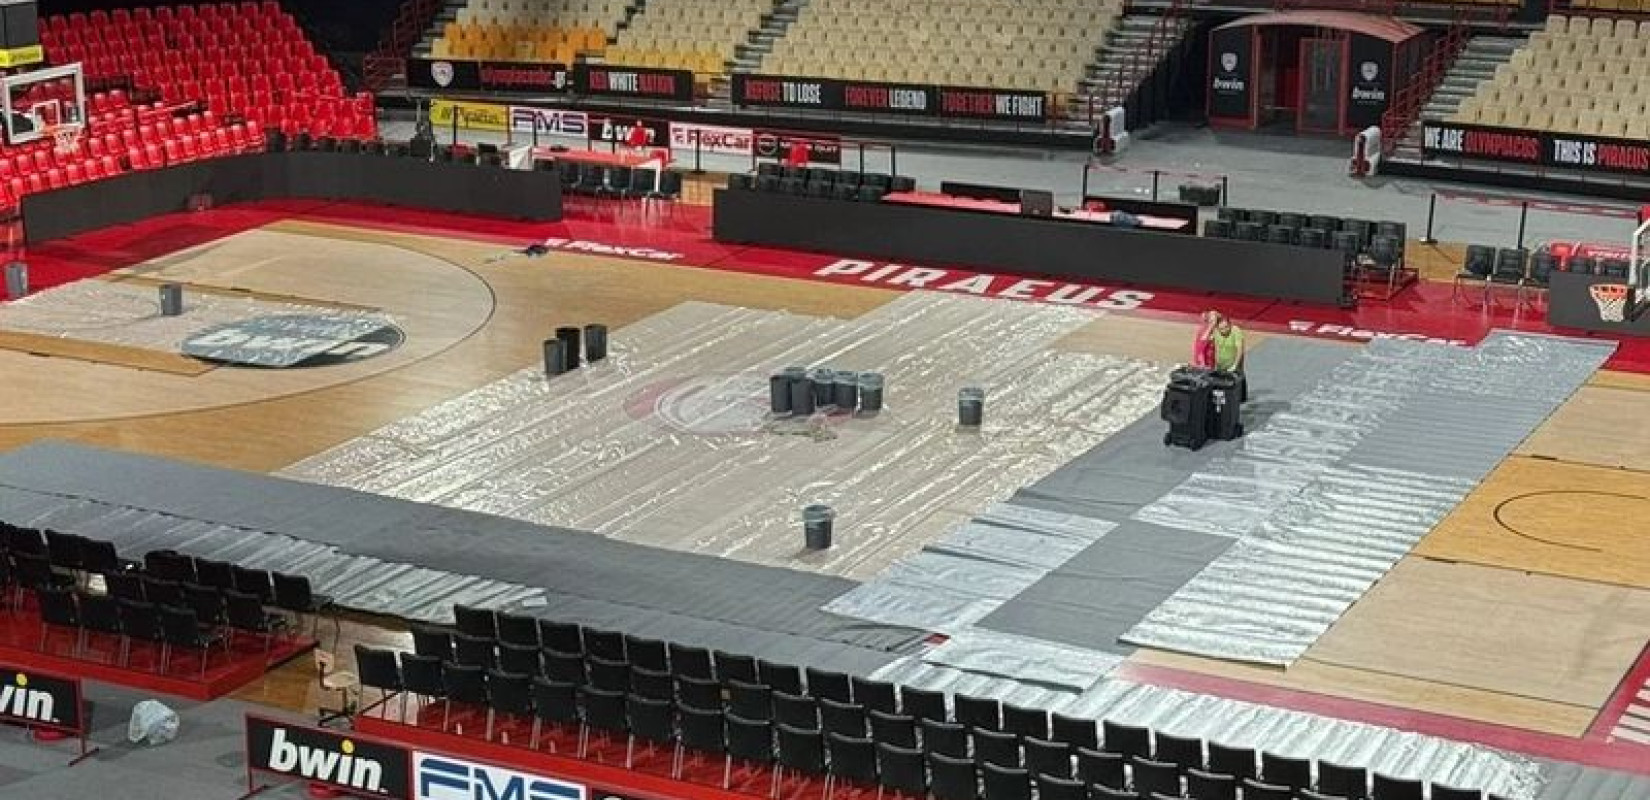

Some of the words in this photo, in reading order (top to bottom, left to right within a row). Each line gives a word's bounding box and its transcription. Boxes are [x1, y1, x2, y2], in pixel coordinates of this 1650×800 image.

[608, 72, 638, 91] WHITE
[639, 74, 675, 93] NATION
[745, 80, 780, 101] REFUSE
[782, 82, 795, 101] TO
[797, 83, 821, 103] LOSE
[845, 85, 888, 107] FOREVER
[889, 89, 927, 110] LEGEND
[941, 91, 995, 113] TOGETHER
[995, 94, 1011, 114] WE
[1011, 95, 1043, 116] FIGHT
[601, 117, 655, 142] bwn
[1424, 127, 1440, 149] WE
[1441, 129, 1463, 151] ARE
[1464, 131, 1538, 159] OLYMPIACOS
[1553, 139, 1580, 163] THIS
[1581, 141, 1596, 165] IS
[1598, 143, 1650, 170] PIRAEUS
[812, 259, 1154, 309] PIRAEUS
